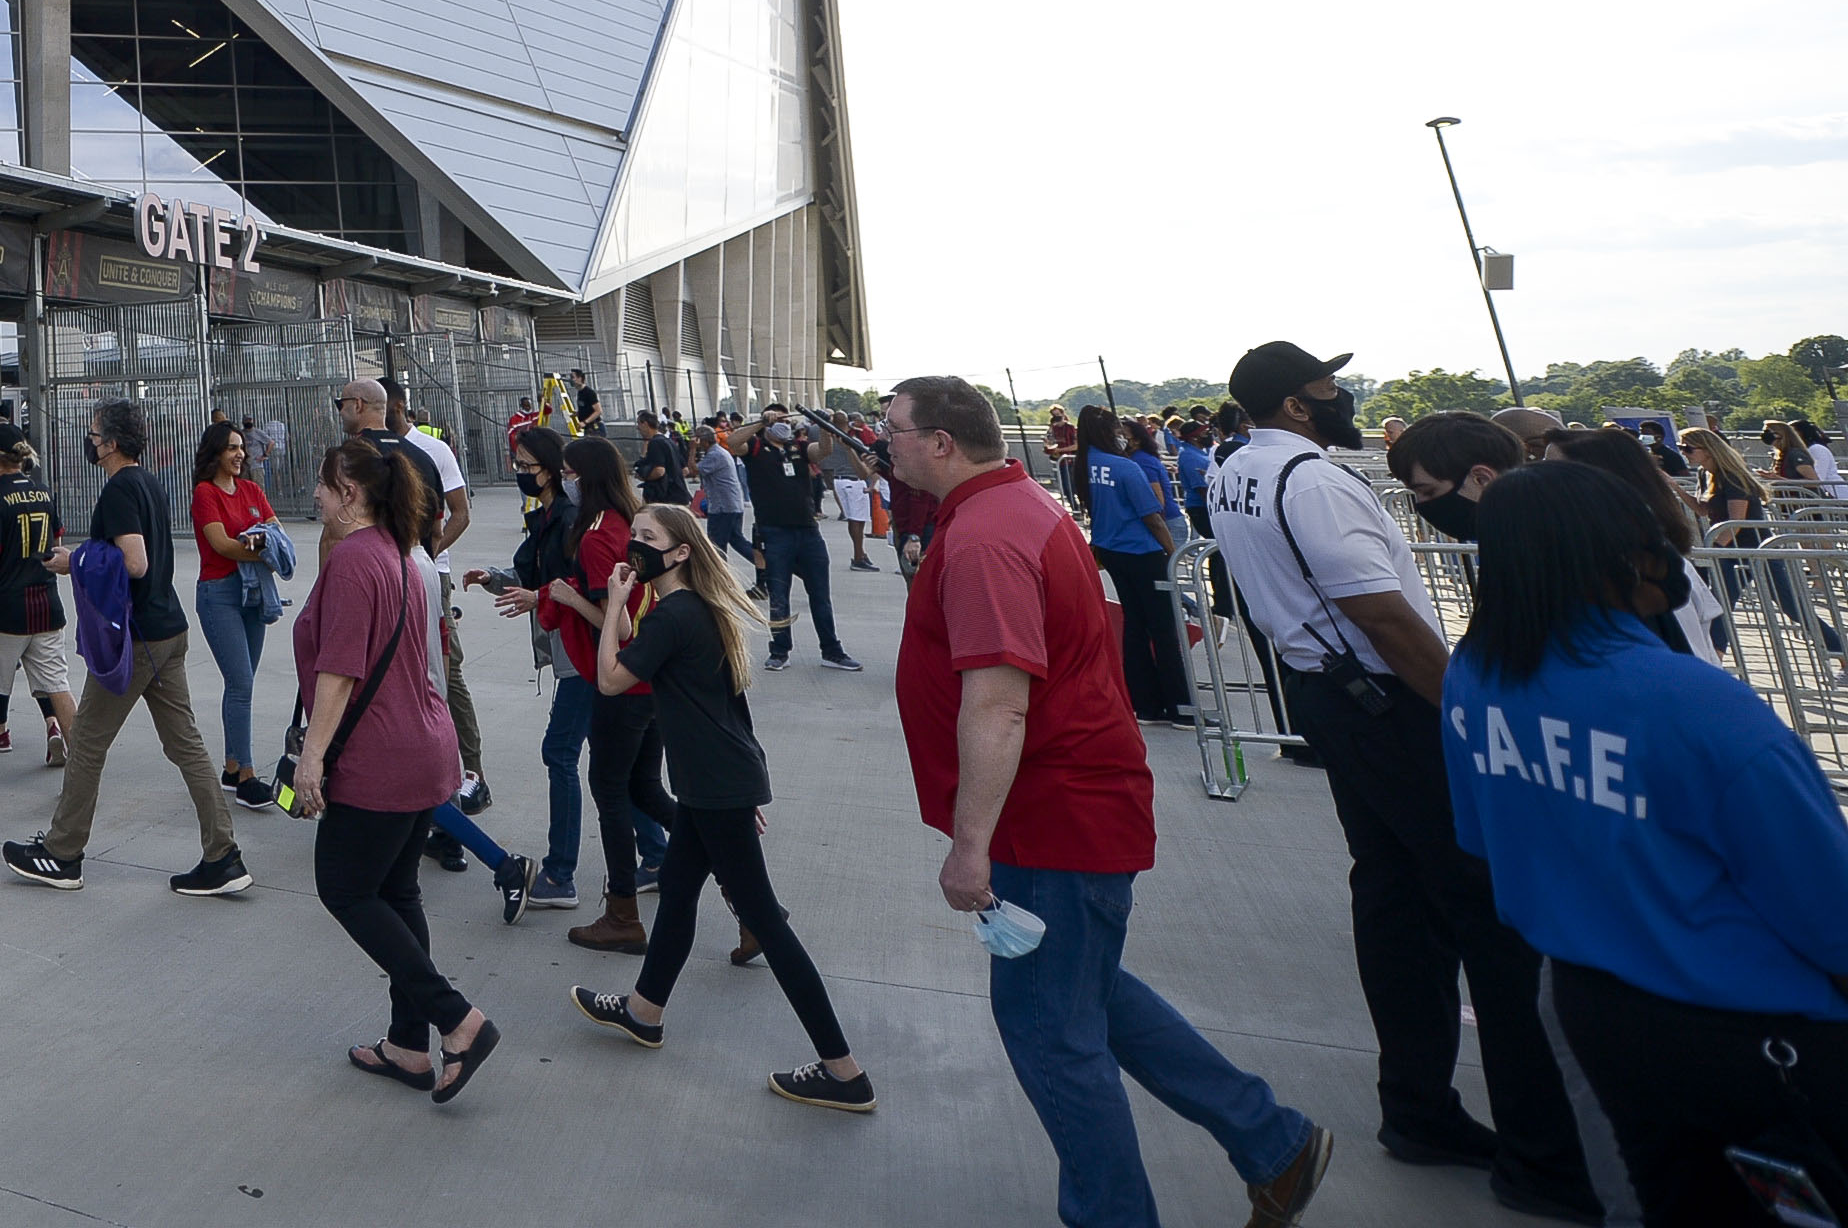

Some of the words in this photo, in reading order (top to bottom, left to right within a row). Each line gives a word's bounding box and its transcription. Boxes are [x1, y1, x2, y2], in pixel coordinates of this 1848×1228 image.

[137, 193, 233, 269] GATE
[239, 215, 260, 273] 2
[102, 261, 129, 282] UNITE
[130, 265, 140, 282] &
[140, 267, 178, 289] CONQUER
[256, 290, 297, 310] CHAMPIONS
[3, 491, 51, 506] WILLSON
[17, 512, 49, 559] 17
